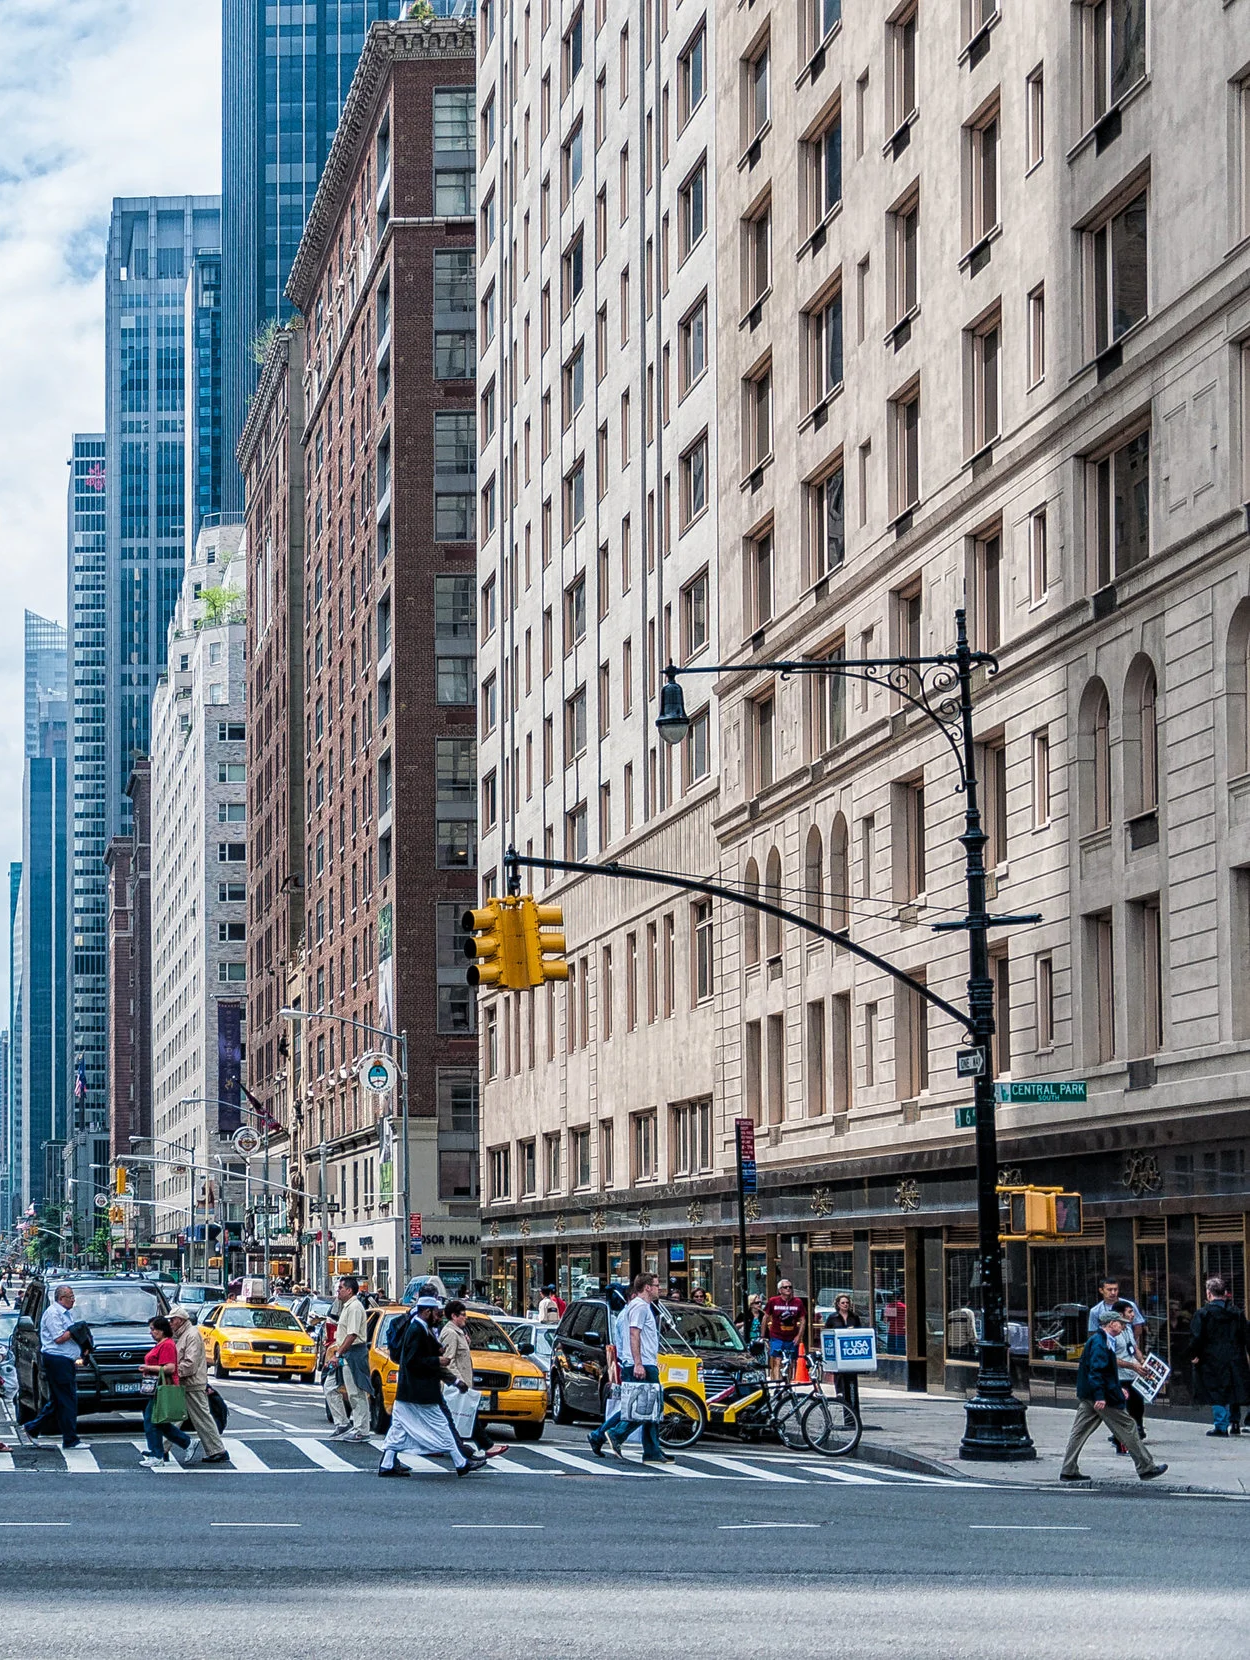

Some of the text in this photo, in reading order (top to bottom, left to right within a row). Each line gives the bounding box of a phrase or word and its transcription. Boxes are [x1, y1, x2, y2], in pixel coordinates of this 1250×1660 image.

[960, 1059, 970, 1069] ONE
[1011, 1083, 1085, 1096] CENTRAL PARK
[965, 1110, 971, 1125] 6
[851, 1340, 869, 1348] USA
[842, 1347, 870, 1356] TODAY
